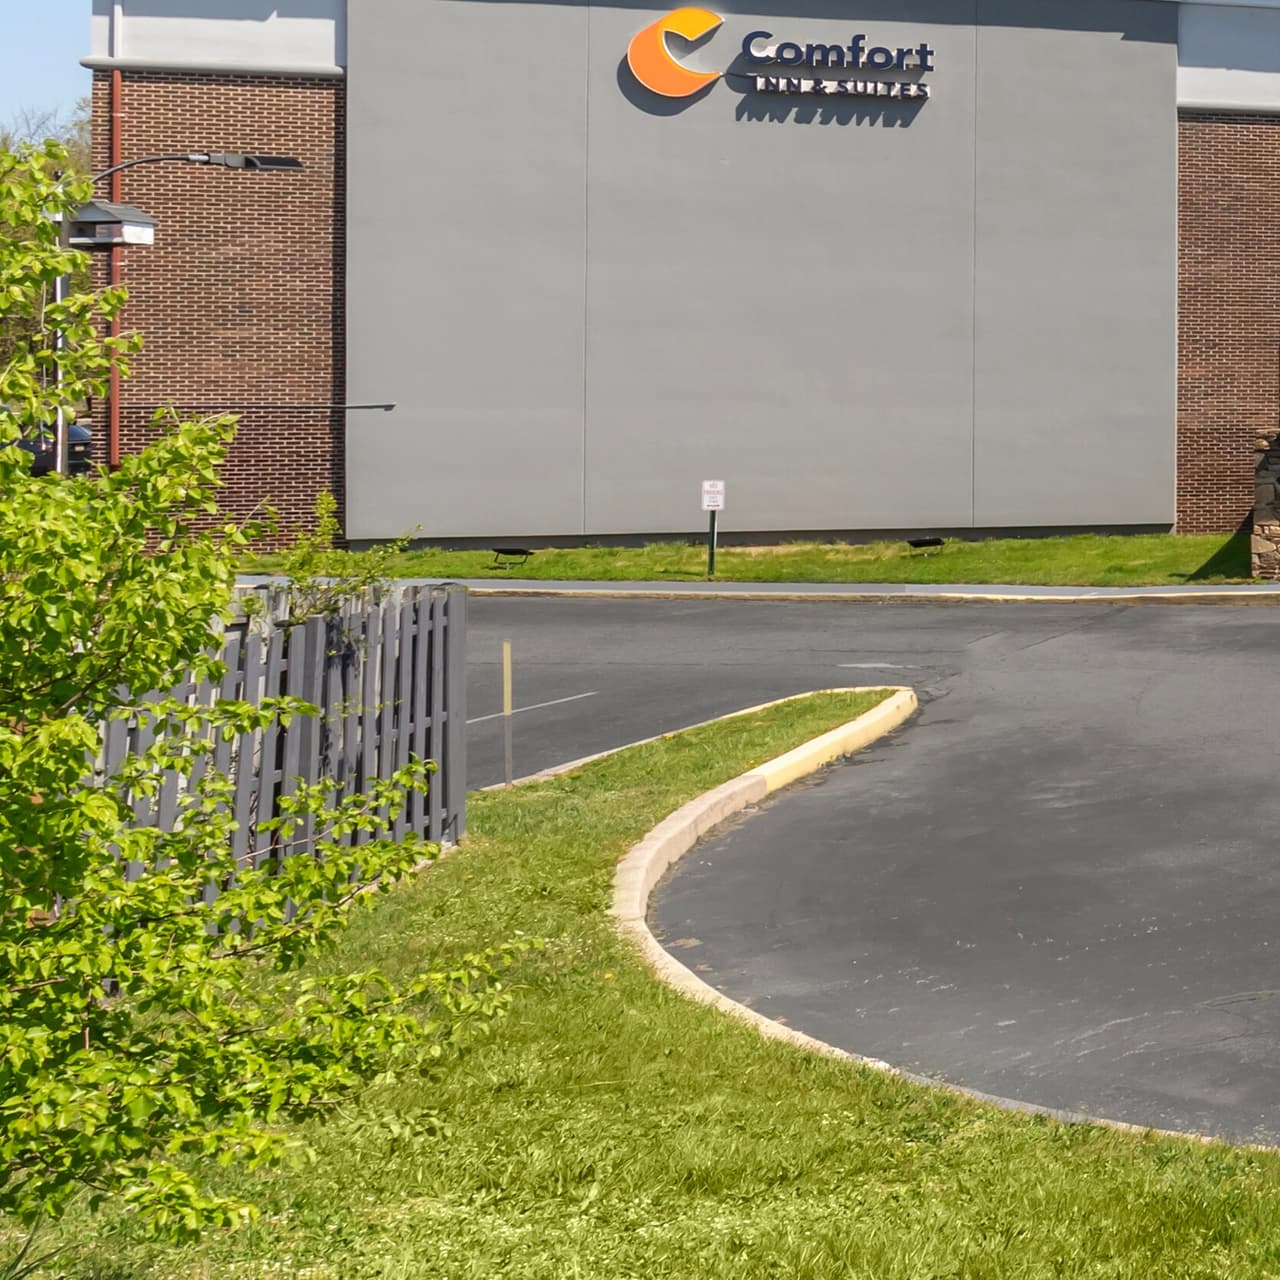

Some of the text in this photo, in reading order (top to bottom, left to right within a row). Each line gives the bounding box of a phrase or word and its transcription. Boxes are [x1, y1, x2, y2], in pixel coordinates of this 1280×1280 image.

[742, 30, 934, 71] Comfort
[753, 75, 930, 98] INN & SUITES
